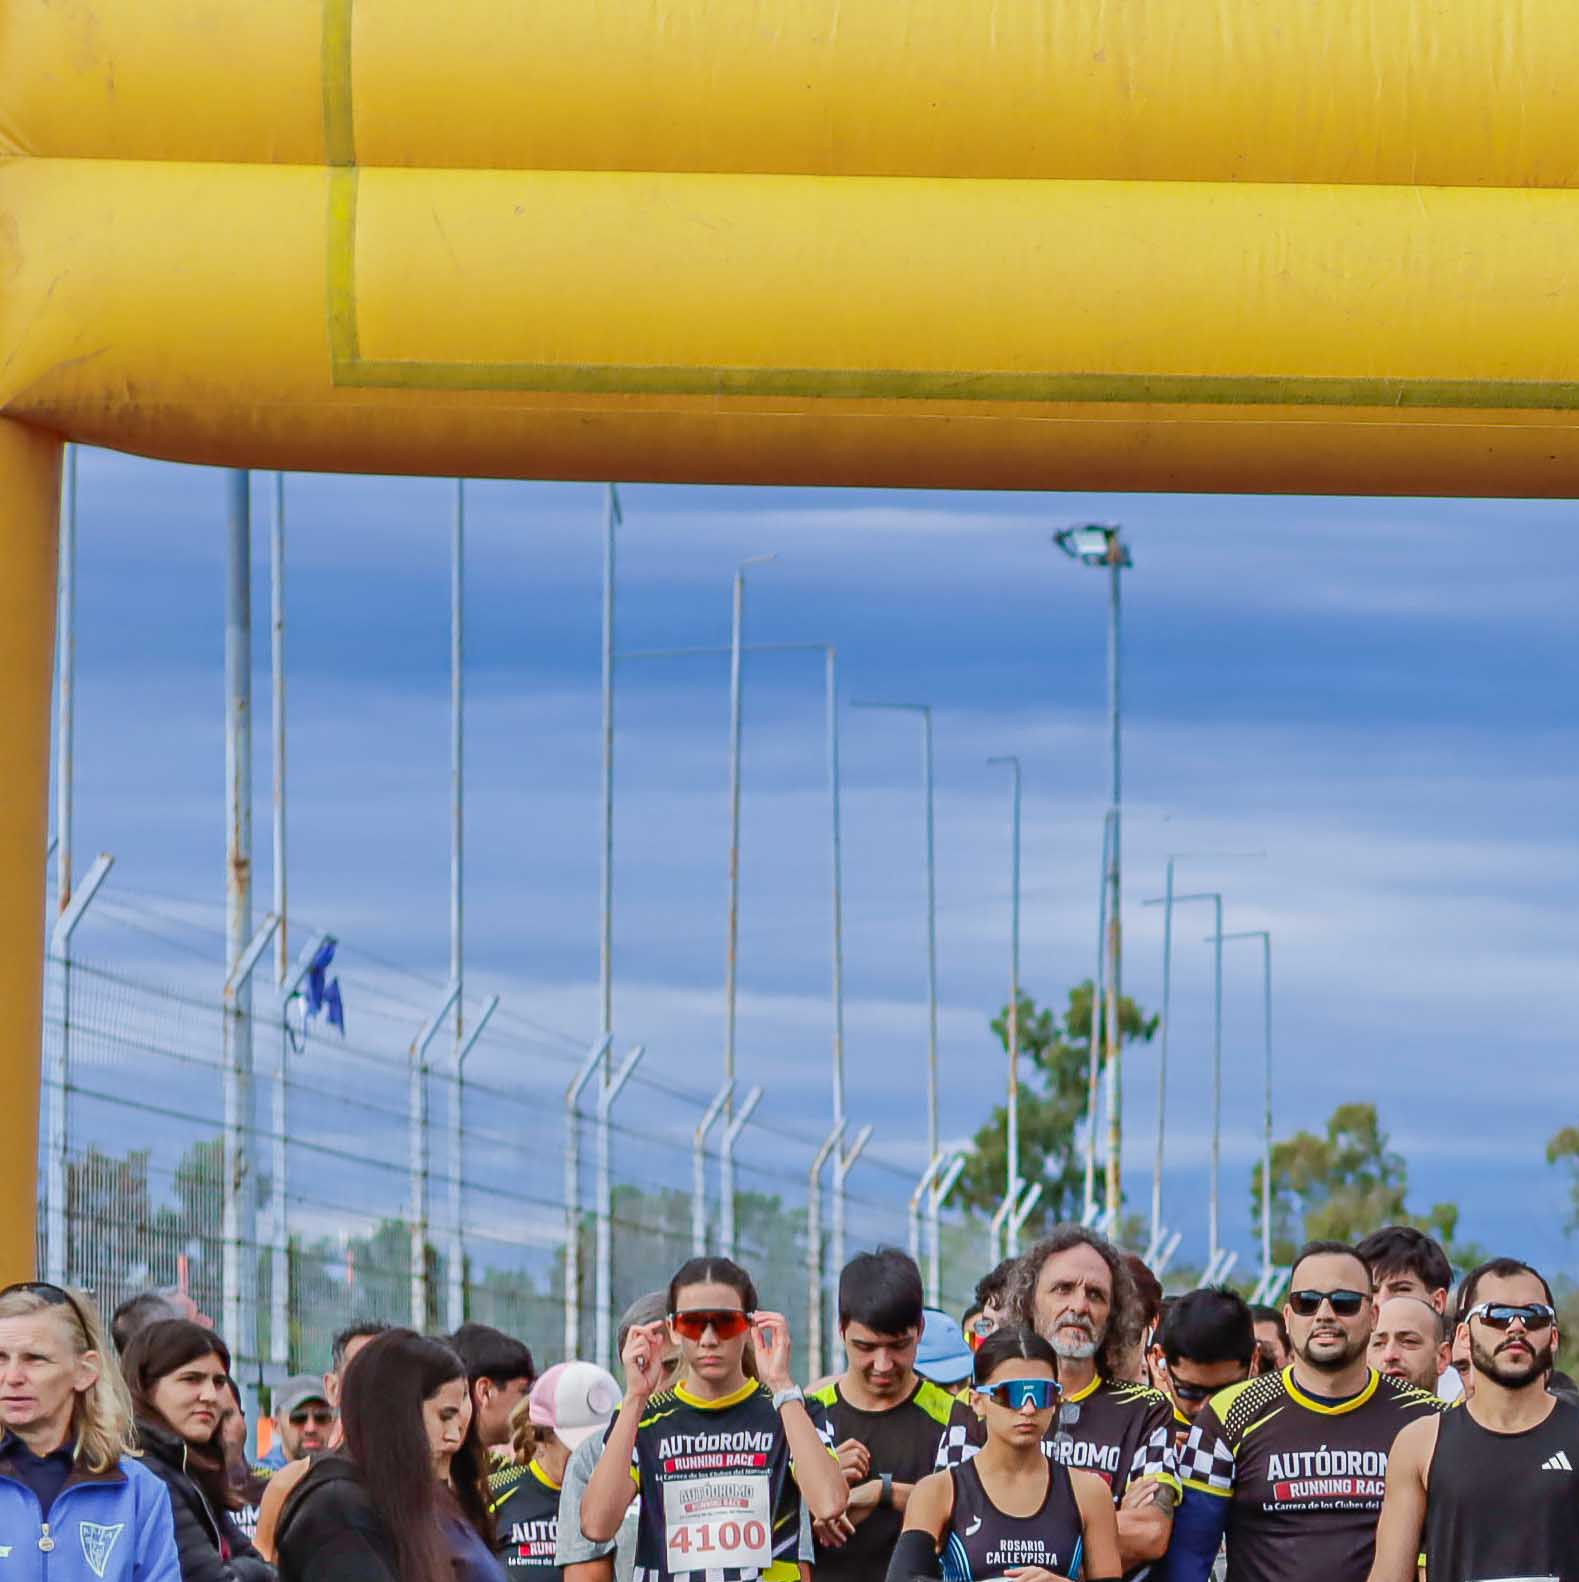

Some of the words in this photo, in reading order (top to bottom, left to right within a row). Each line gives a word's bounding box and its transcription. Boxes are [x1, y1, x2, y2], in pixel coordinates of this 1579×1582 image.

[658, 1431, 774, 1459] AUTÓDROMO
[726, 1452, 754, 1467] RACE
[1290, 1480, 1352, 1499] RUNNING
[1263, 1502, 1273, 1511] La
[1274, 1501, 1306, 1511] Carrera
[1308, 1500, 1319, 1510] de
[1320, 1500, 1334, 1509] los
[1335, 1500, 1364, 1510] Clubes
[669, 1520, 766, 1554] 4100
[1000, 1539, 1045, 1552] ROSARIO
[986, 1551, 1057, 1566] CALLEYPISTA
